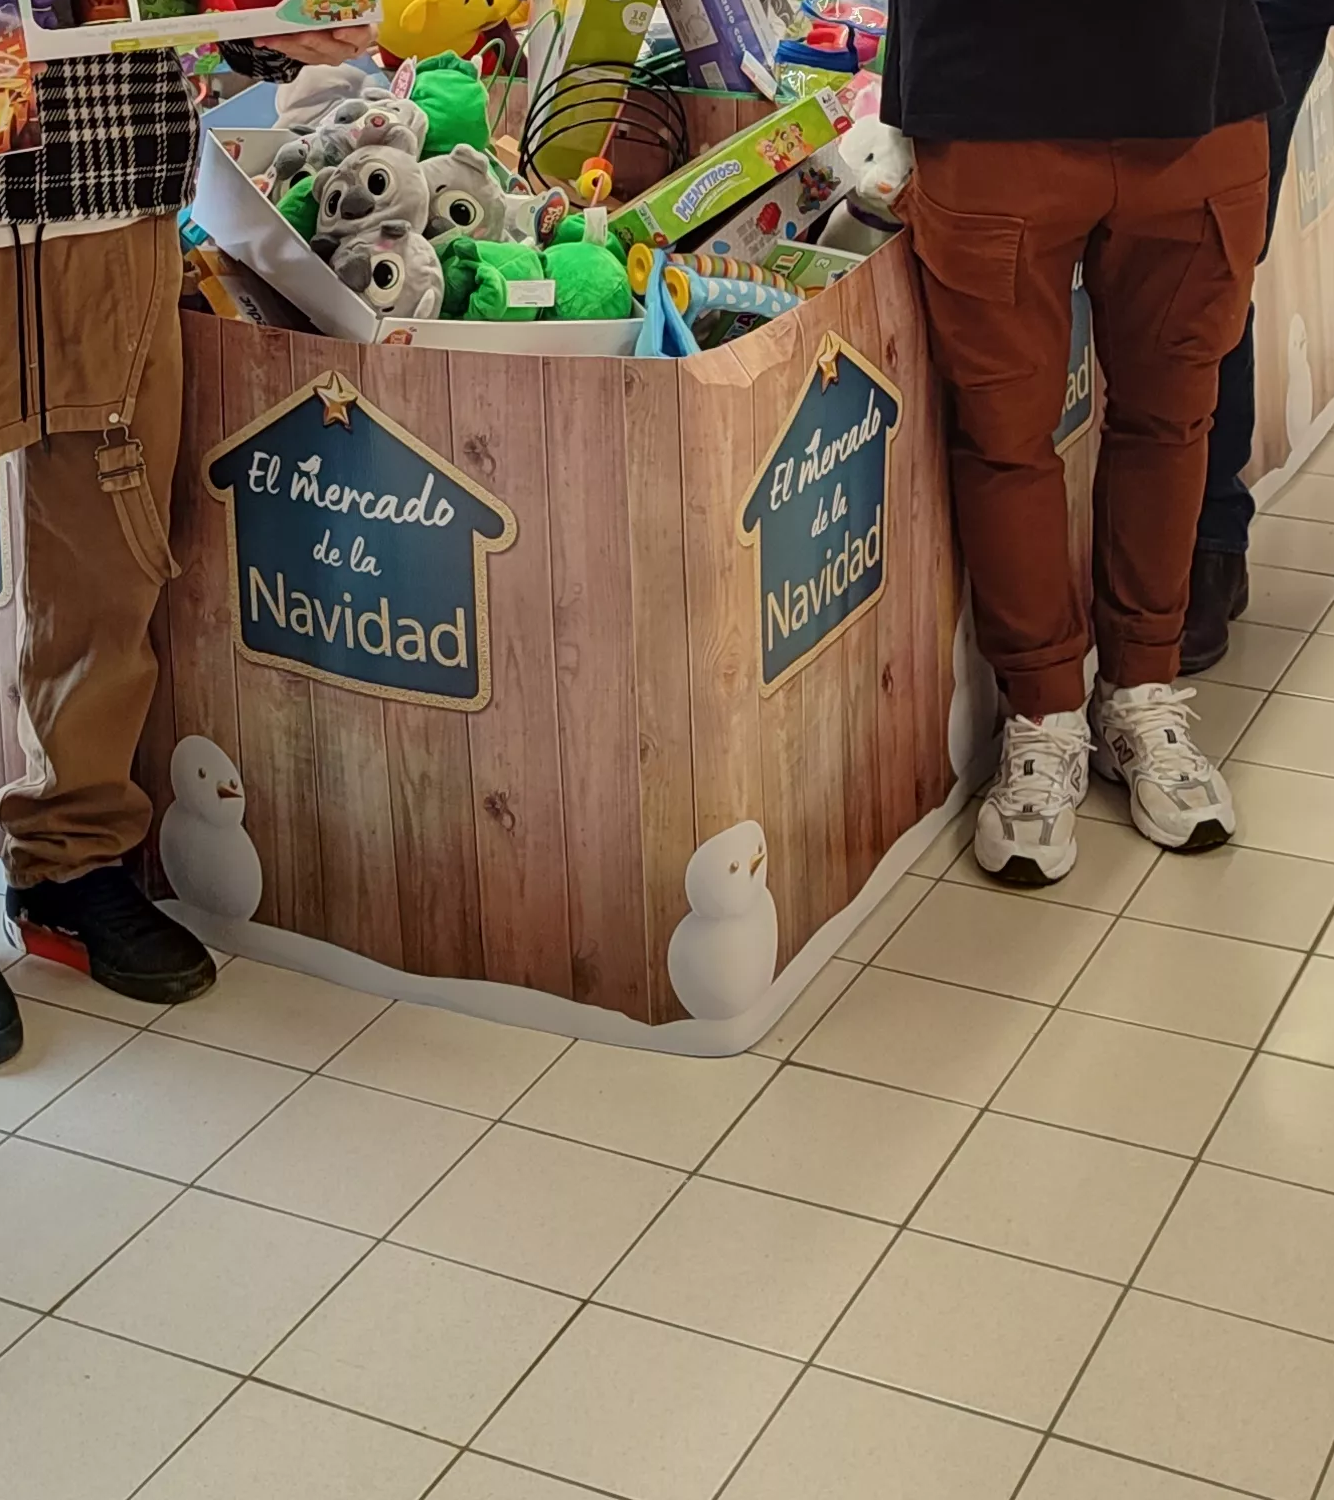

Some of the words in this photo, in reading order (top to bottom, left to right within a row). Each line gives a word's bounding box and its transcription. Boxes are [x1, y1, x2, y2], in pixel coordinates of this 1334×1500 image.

[630, 9, 648, 21] 18
[769, 461, 794, 513] El
[797, 388, 883, 494] mercado
[248, 451, 281, 495] El
[290, 470, 456, 529] mercado
[811, 506, 829, 541] de
[829, 481, 850, 525] la
[312, 529, 345, 569] de
[349, 536, 383, 578] la
[766, 505, 883, 652] Navidad
[248, 566, 470, 669] Navidad
